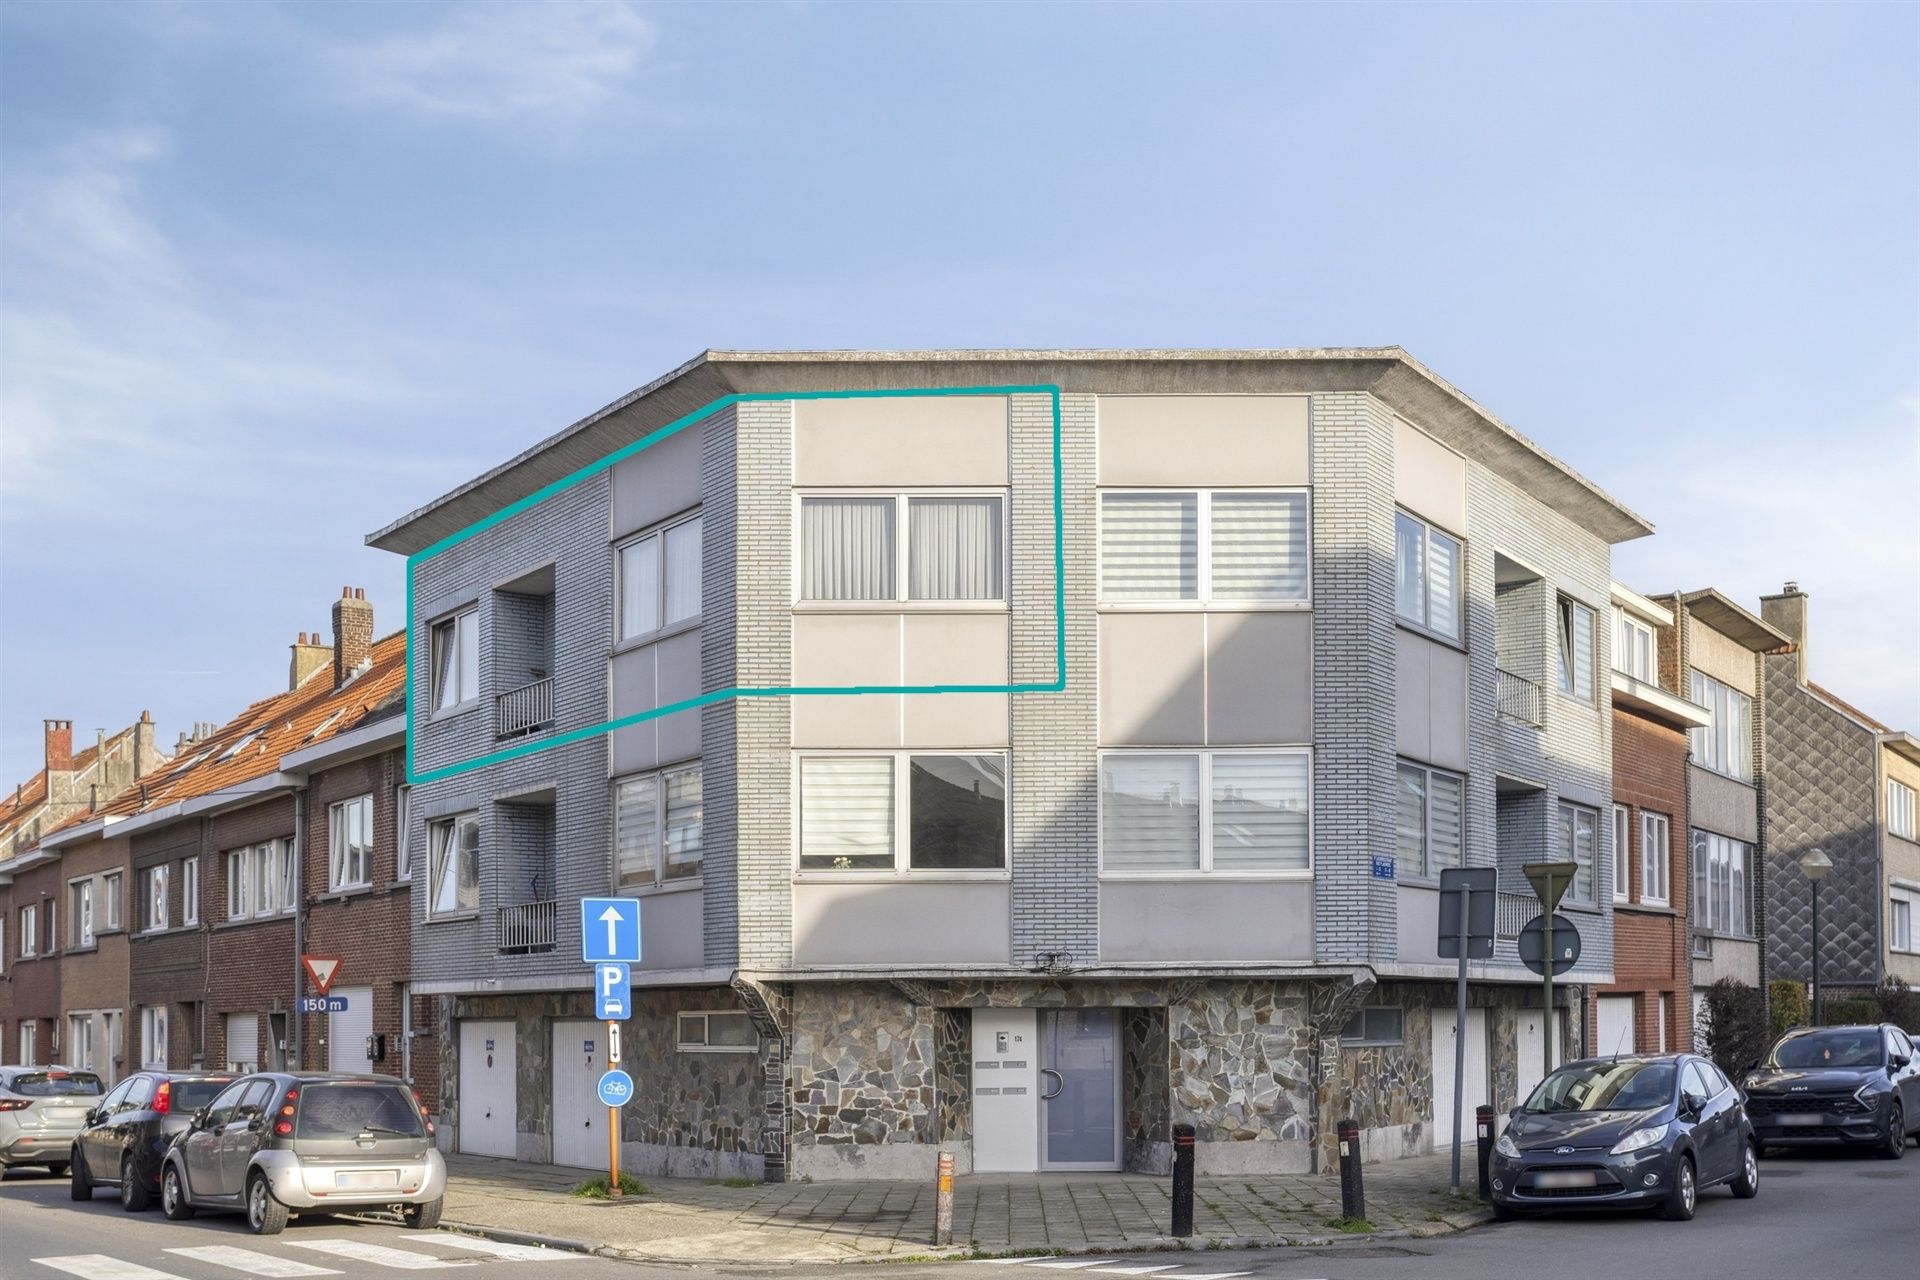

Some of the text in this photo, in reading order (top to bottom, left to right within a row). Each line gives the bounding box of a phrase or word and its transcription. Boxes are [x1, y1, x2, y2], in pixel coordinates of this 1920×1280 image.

[603, 966, 622, 996] P
[304, 998, 341, 1011] 150 m
